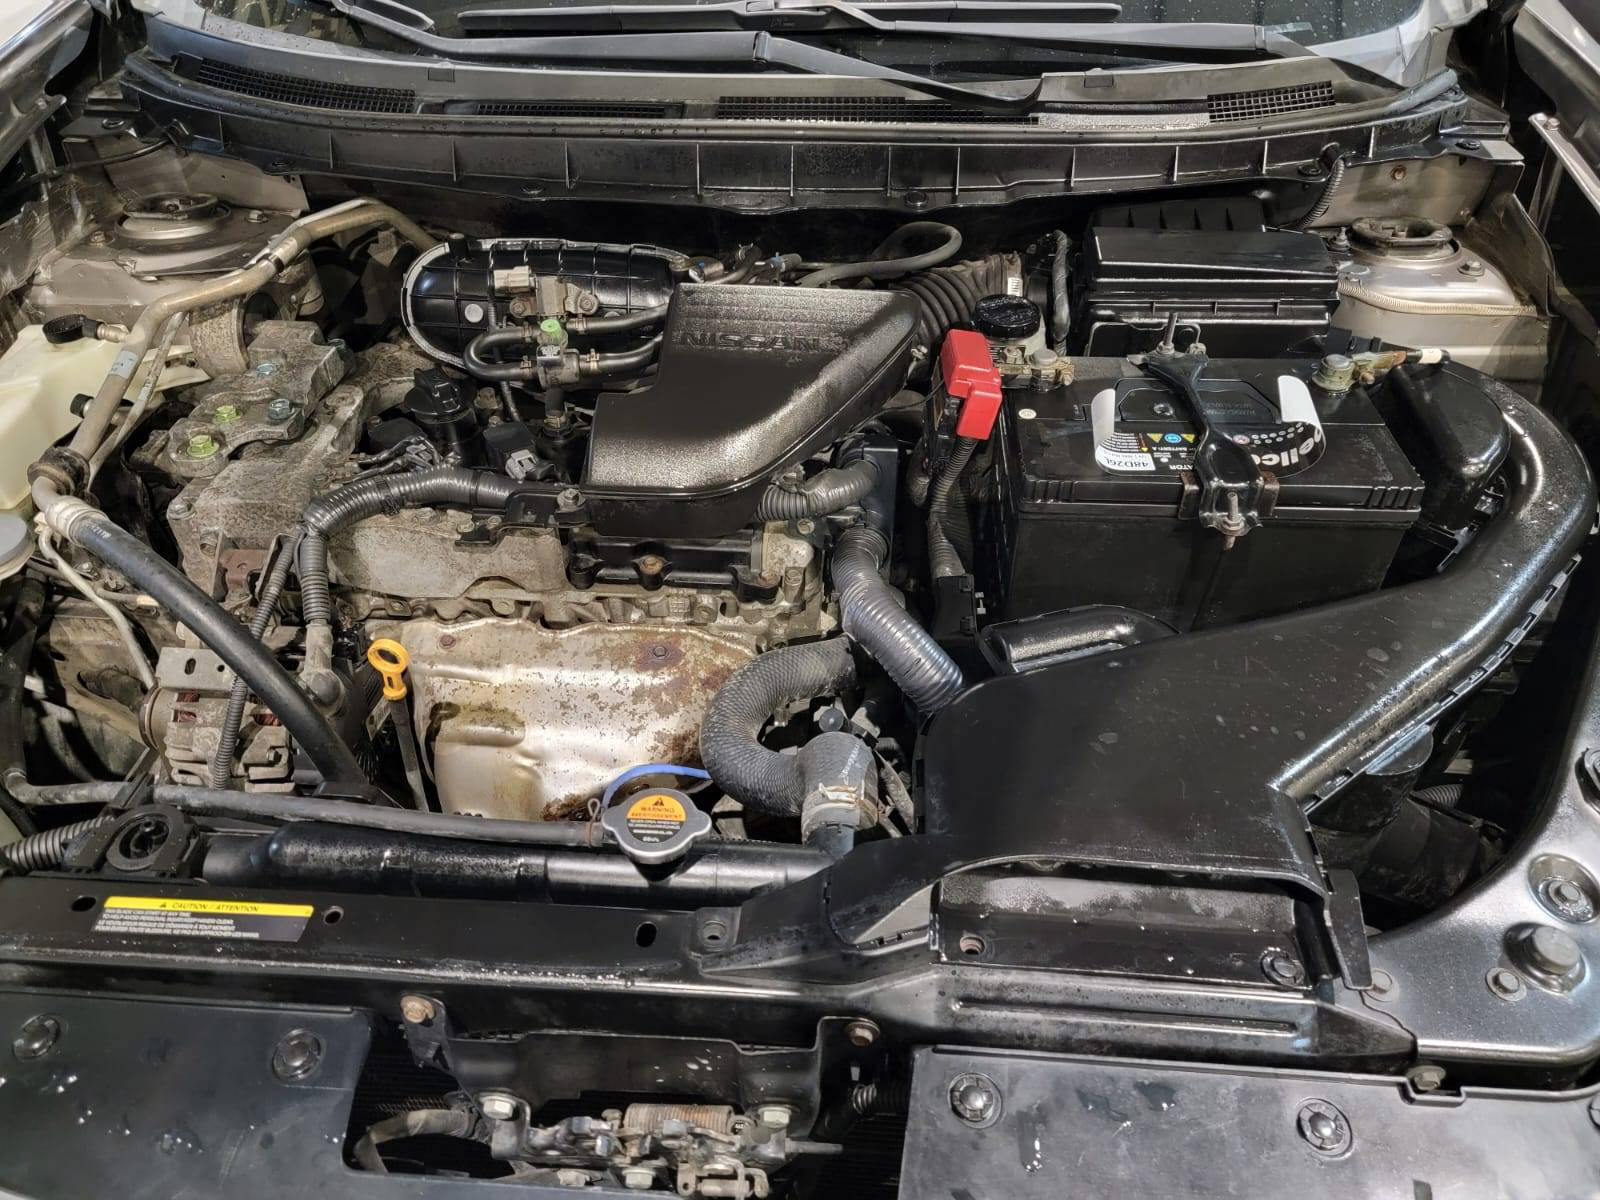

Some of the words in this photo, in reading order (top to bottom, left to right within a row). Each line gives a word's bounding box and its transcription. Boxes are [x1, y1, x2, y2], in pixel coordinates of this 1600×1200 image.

[680, 332, 820, 351] NISSAN
[640, 806, 676, 814] WARNING
[171, 901, 208, 910] CAUTION
[215, 904, 260, 913] ATTENTION
